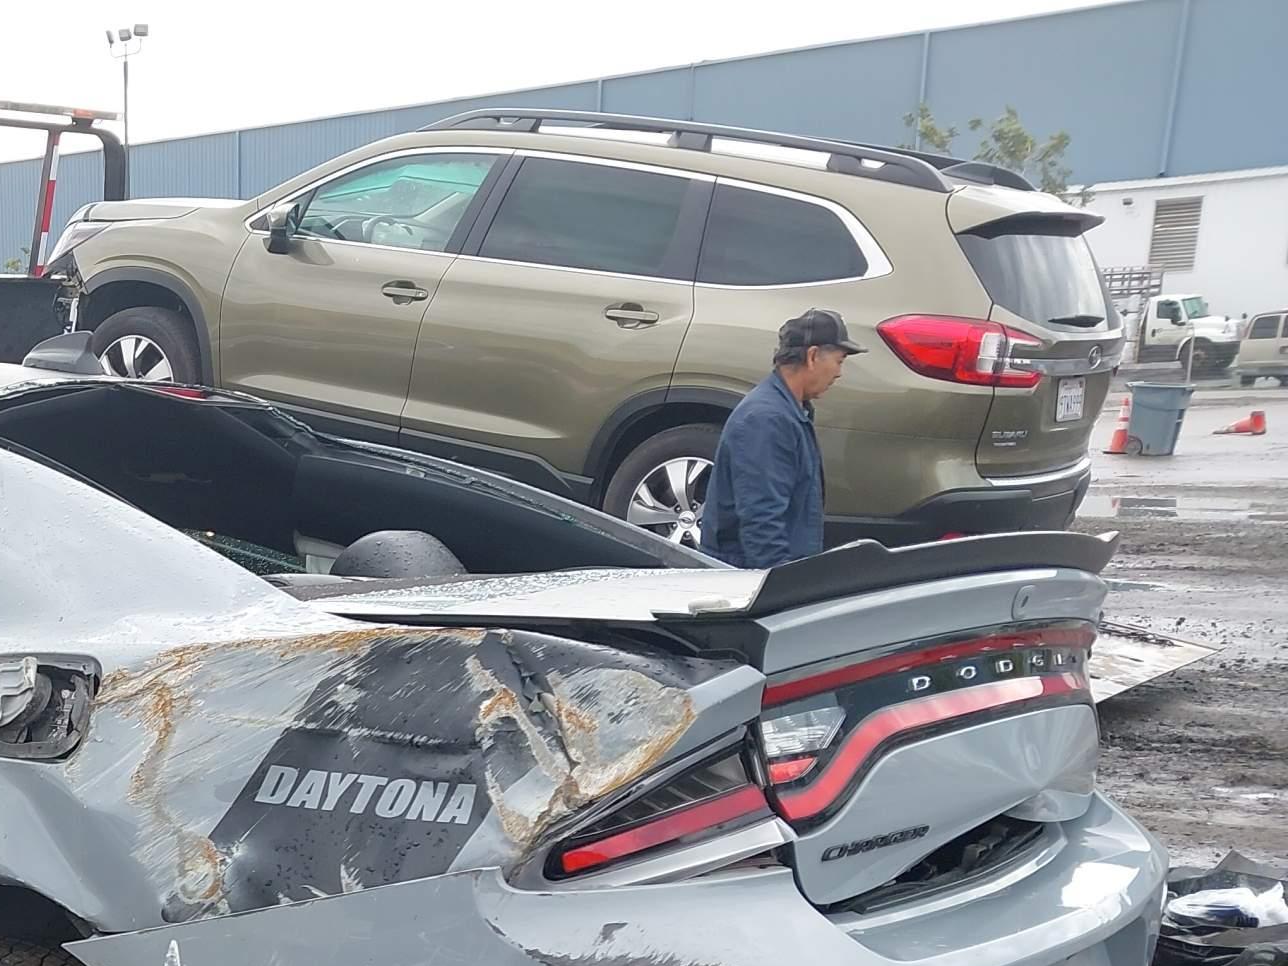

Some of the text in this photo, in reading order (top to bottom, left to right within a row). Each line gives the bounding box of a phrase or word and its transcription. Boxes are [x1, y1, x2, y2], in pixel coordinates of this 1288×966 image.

[991, 430, 1029, 439] SUBARU
[254, 765, 477, 825] DAYTONA
[821, 824, 931, 862] CHARGER
